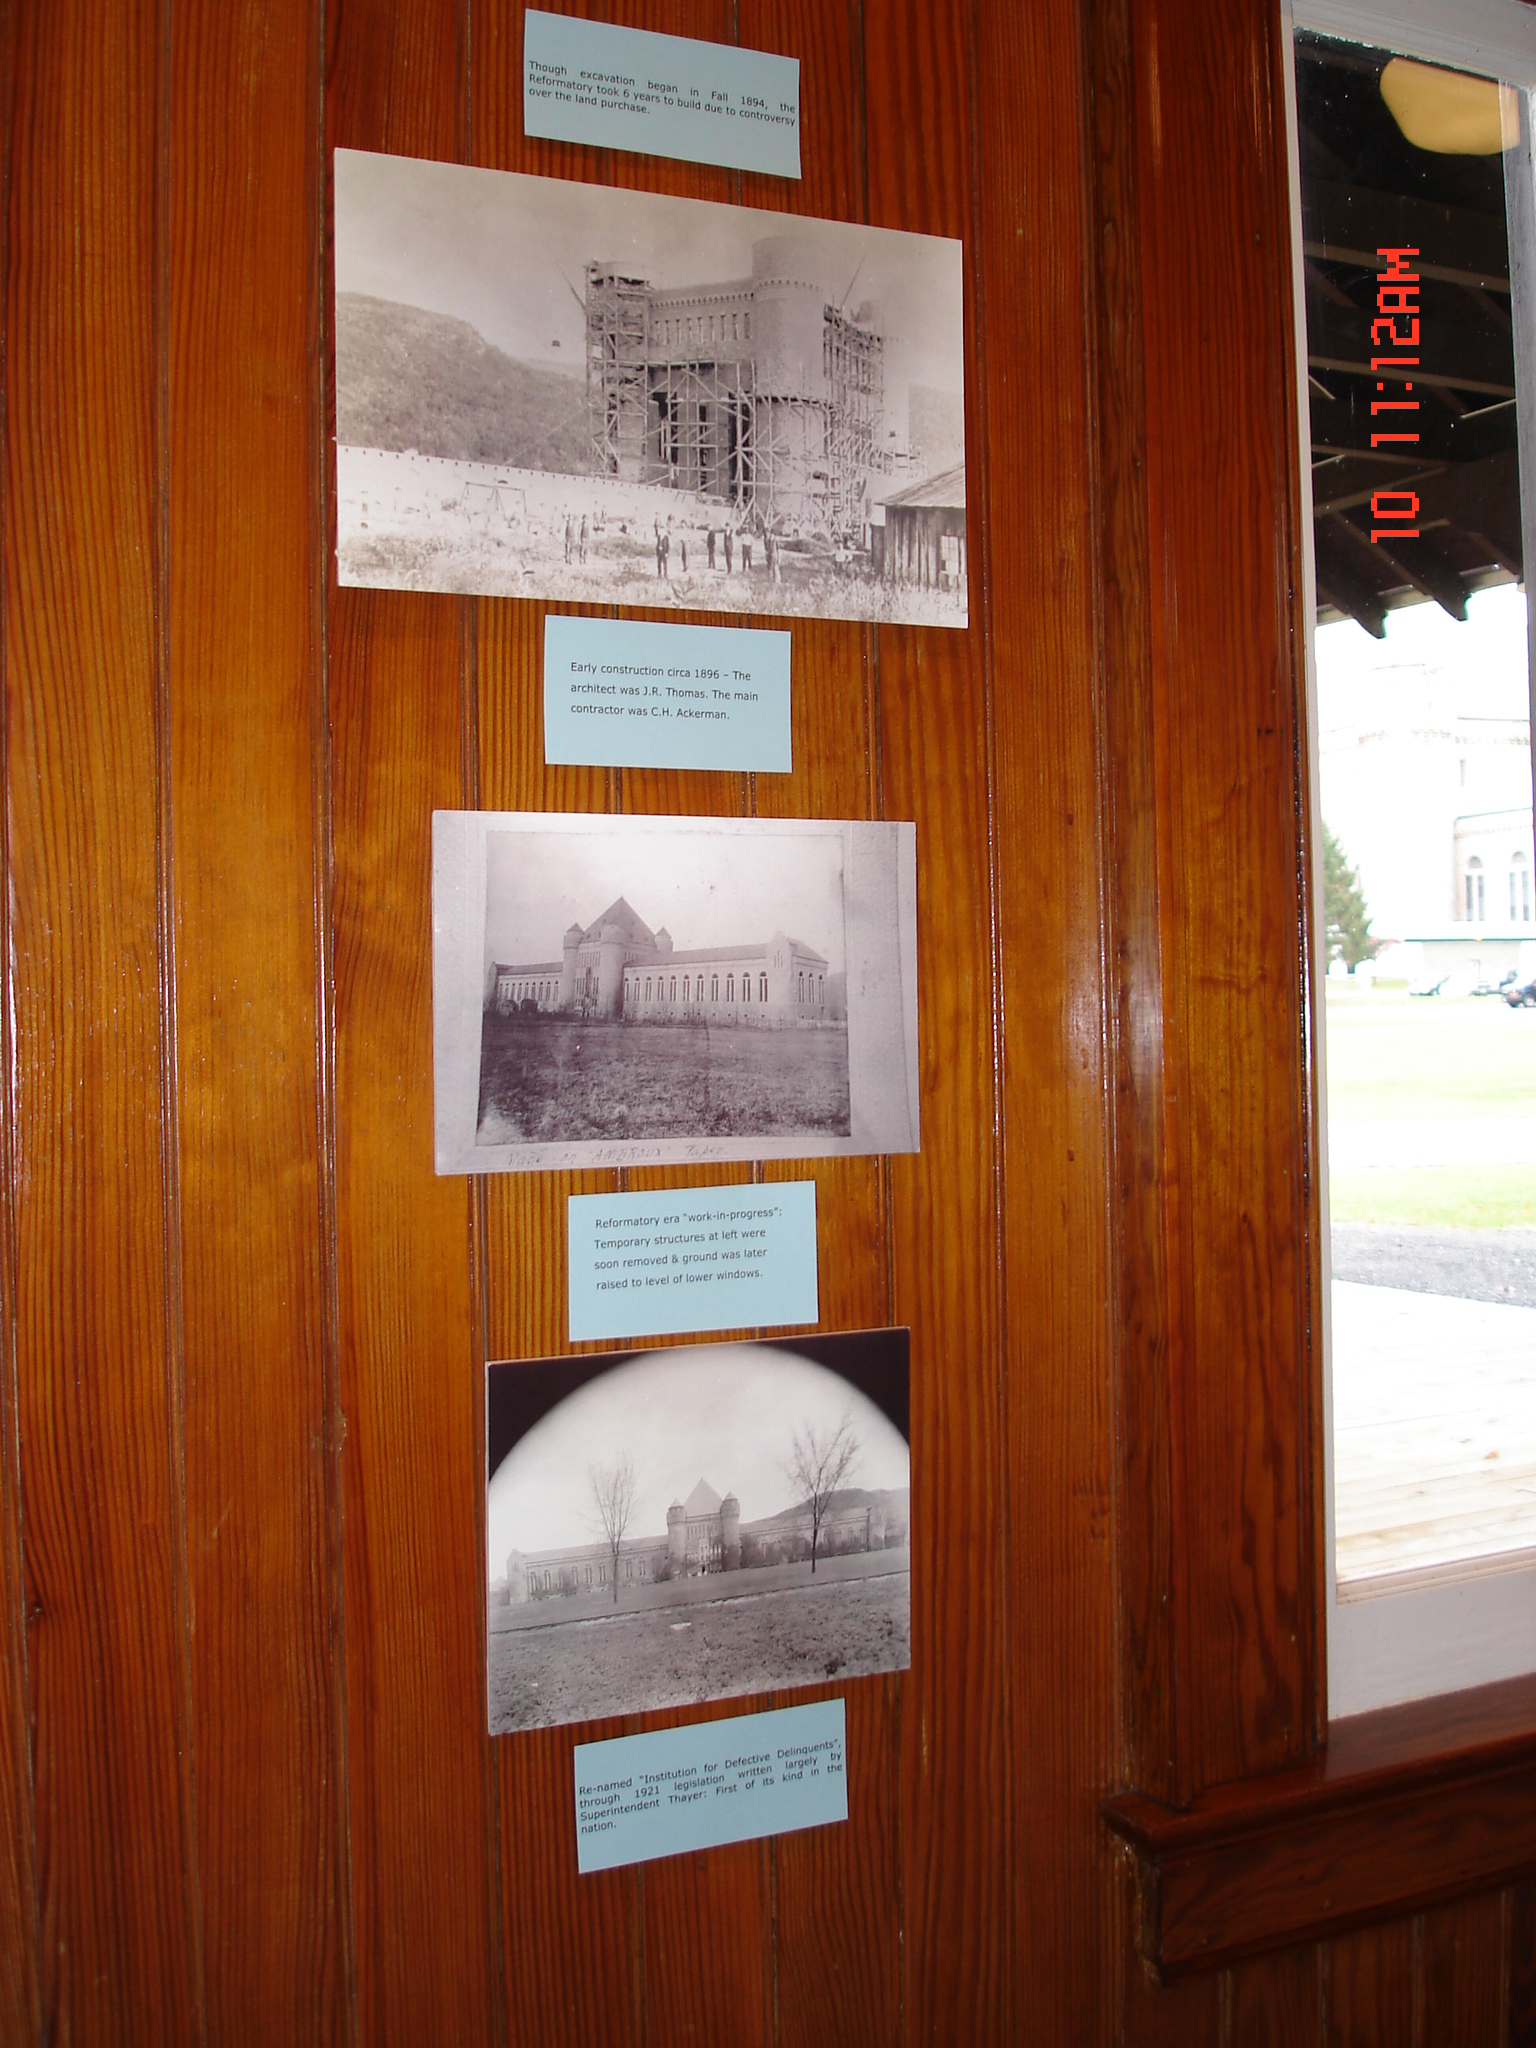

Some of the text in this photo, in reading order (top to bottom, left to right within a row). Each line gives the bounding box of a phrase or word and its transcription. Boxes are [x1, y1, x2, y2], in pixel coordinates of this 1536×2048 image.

[529, 61, 795, 113] Though excavation began in Fall 1894, the
[529, 74, 795, 127] Reformatory took 6 years to build due to controversy
[529, 88, 650, 114] over the land purchase.
[571, 662, 597, 674] Early
[601, 665, 664, 676] construction
[668, 668, 690, 678] circa
[695, 669, 720, 679] 1896
[733, 671, 751, 681] The
[571, 684, 758, 701] architect was J.R. Thomas. The main
[571, 705, 730, 720] contractor was C.H. Ackerman.
[595, 1215, 660, 1229] Reformatory
[664, 1214, 680, 1224] era
[594, 1229, 766, 1249] Temporary structures at left were
[595, 1248, 767, 1269] soon removed & ground was later
[596, 1268, 762, 1290] raised to level of lower windows.
[579, 1778, 632, 1796] Re-named
[704, 1763, 717, 1772] for
[725, 1752, 770, 1769] Defective
[579, 1752, 841, 1809] through 1921 legislation written largely by
[580, 1763, 842, 1822] Superintendent Thayer: First of its kind in the
[581, 1820, 617, 1834] nation.
